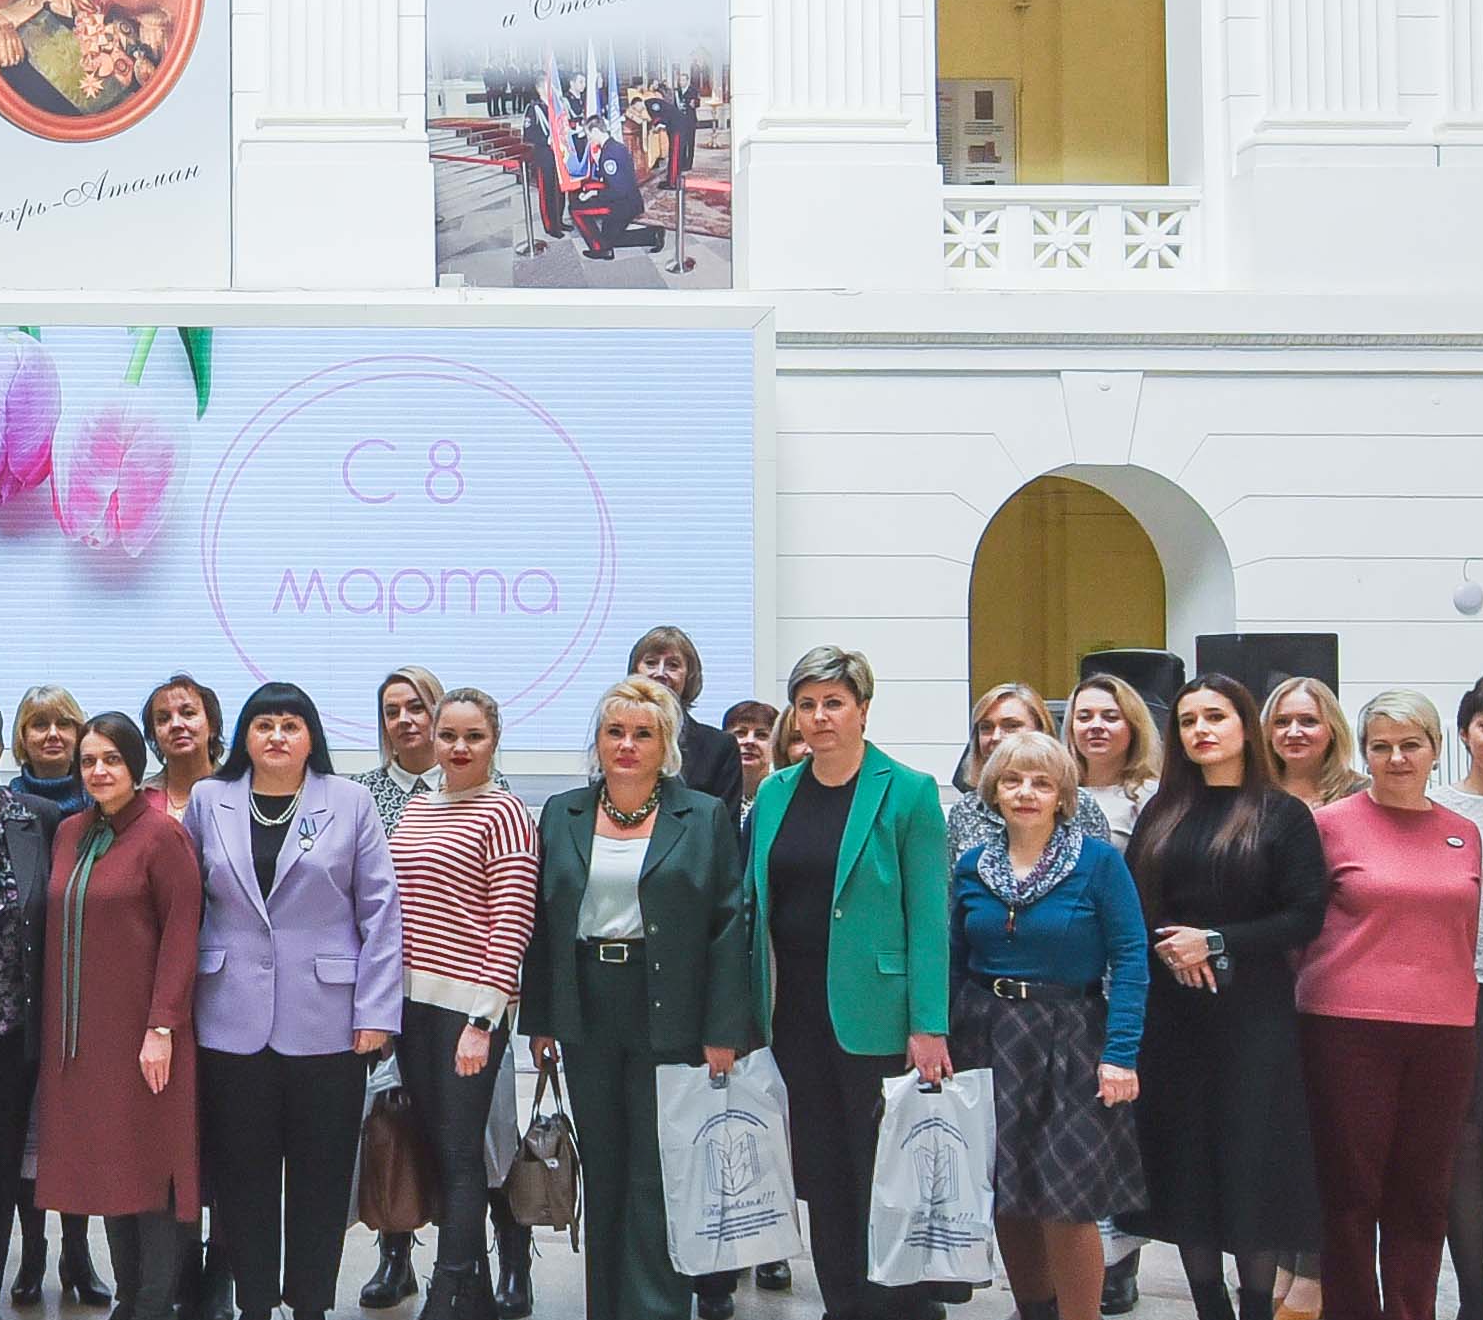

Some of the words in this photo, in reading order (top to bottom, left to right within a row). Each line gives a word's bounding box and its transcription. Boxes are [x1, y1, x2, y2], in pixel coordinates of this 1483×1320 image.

[501, 12, 518, 29] и
[342, 438, 397, 505] С
[424, 439, 465, 505] 8
[272, 567, 559, 633] марта
